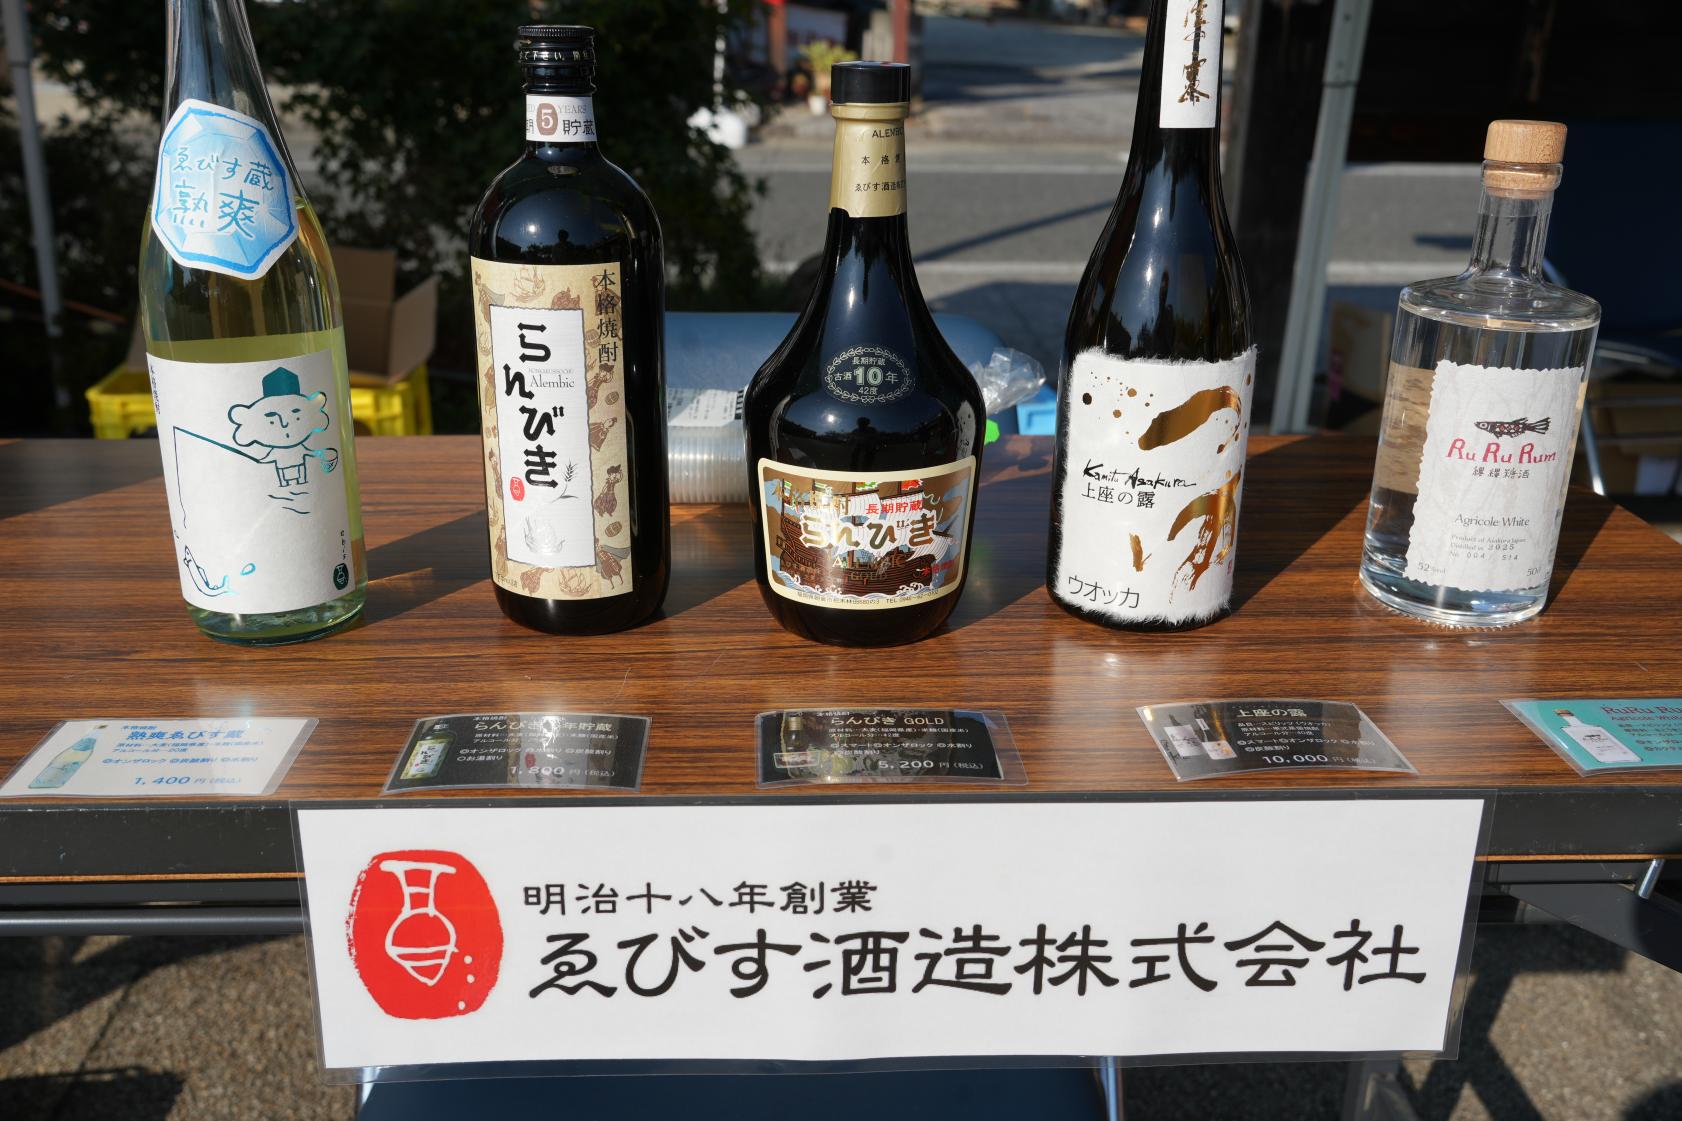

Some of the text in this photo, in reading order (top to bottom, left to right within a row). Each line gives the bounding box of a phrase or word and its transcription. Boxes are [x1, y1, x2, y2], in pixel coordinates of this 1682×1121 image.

[541, 109, 554, 129] 5
[563, 119, 595, 136] 貯蔵
[558, 104, 586, 114] YEARS
[174, 147, 274, 191] ゑびす蔵
[173, 180, 260, 239] 熟爽
[596, 269, 618, 364] 本格焼酎
[852, 357, 886, 366] 長期貯蔵
[530, 374, 575, 388] Alembic
[502, 322, 564, 489] らんびき
[1445, 438, 1557, 464] Ru Ru Rum
[865, 500, 923, 515] 長期貯蔵
[1081, 482, 1156, 509] 上座の露
[801, 512, 936, 549] らんびき
[1454, 513, 1530, 528] Agricole White
[1068, 575, 1140, 609] ウオッカ
[831, 716, 944, 726] らんびき GOLD
[1236, 708, 1307, 718] 上座の露
[522, 879, 879, 916] 明治十八年創業
[528, 918, 1427, 999] ゑびす酒造株式会社
